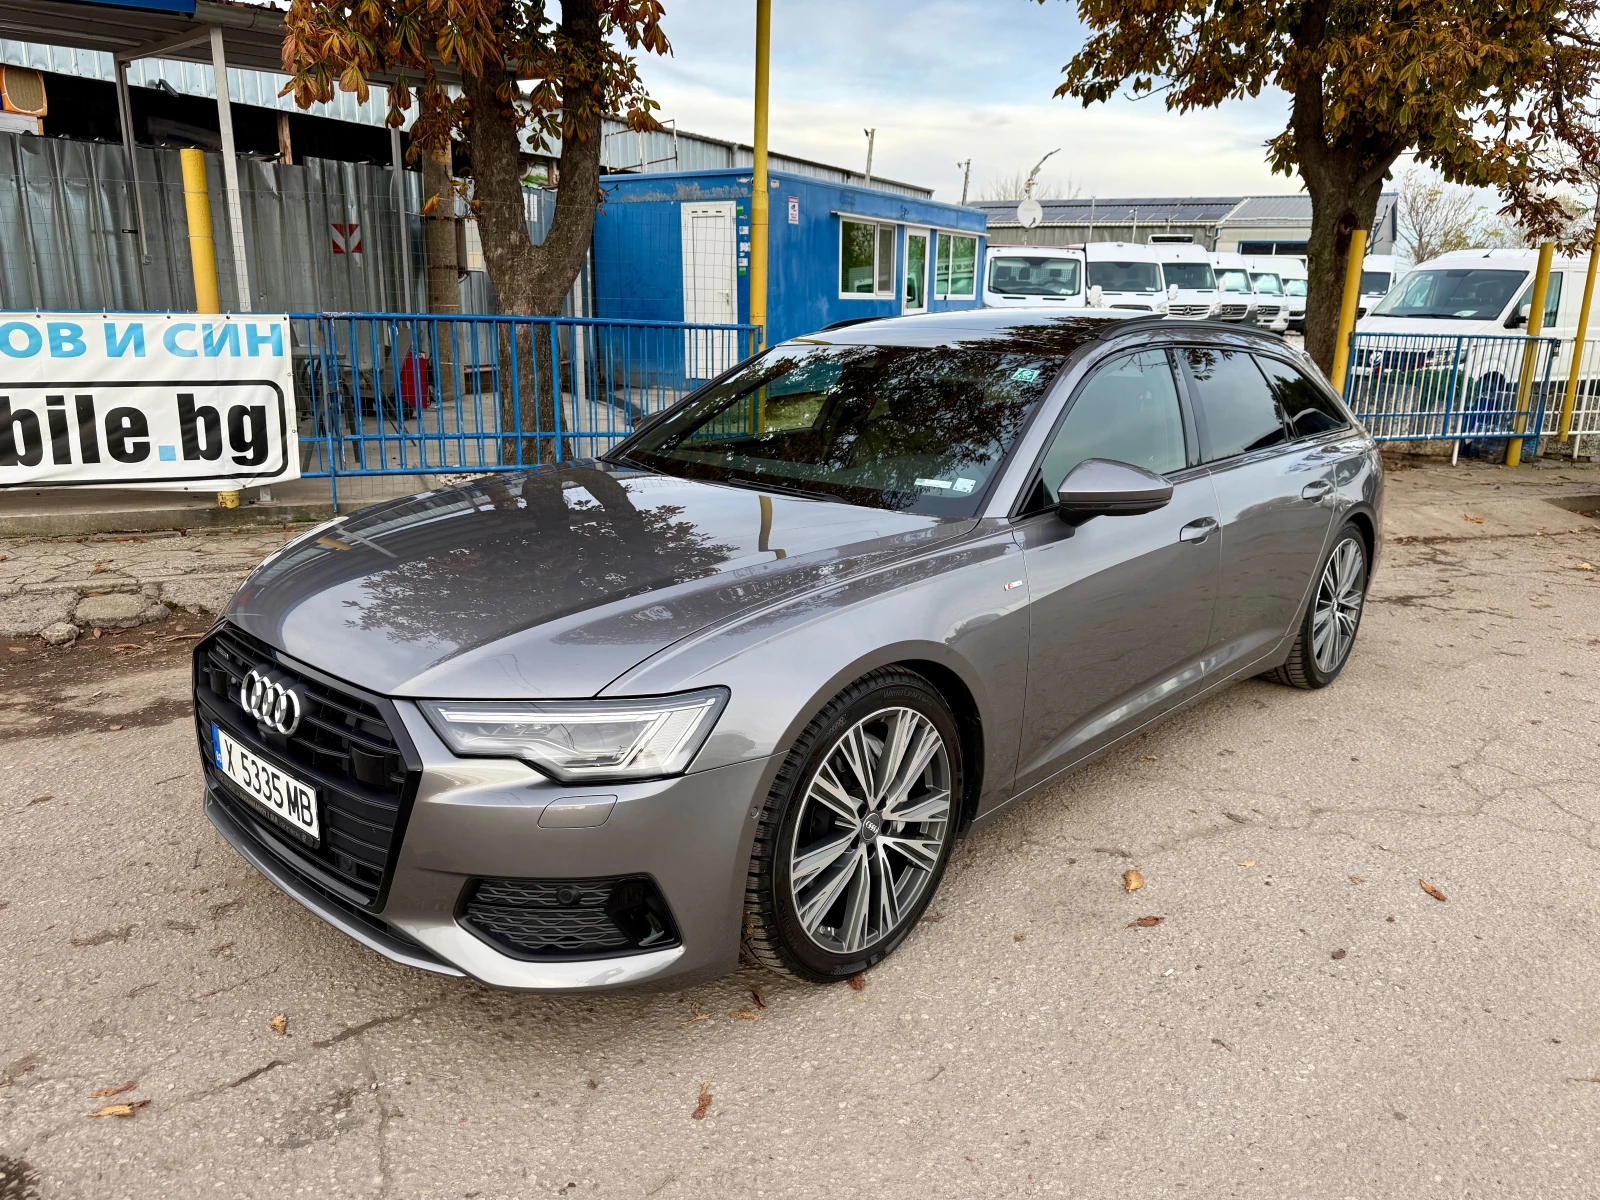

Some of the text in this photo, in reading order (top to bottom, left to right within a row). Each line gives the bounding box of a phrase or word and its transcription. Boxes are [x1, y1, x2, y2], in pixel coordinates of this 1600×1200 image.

[0, 322, 283, 358] ОВ И СИН
[0, 393, 269, 466] bile.bg
[225, 739, 236, 777] X
[241, 754, 284, 809] 5335
[286, 781, 314, 827] MB
